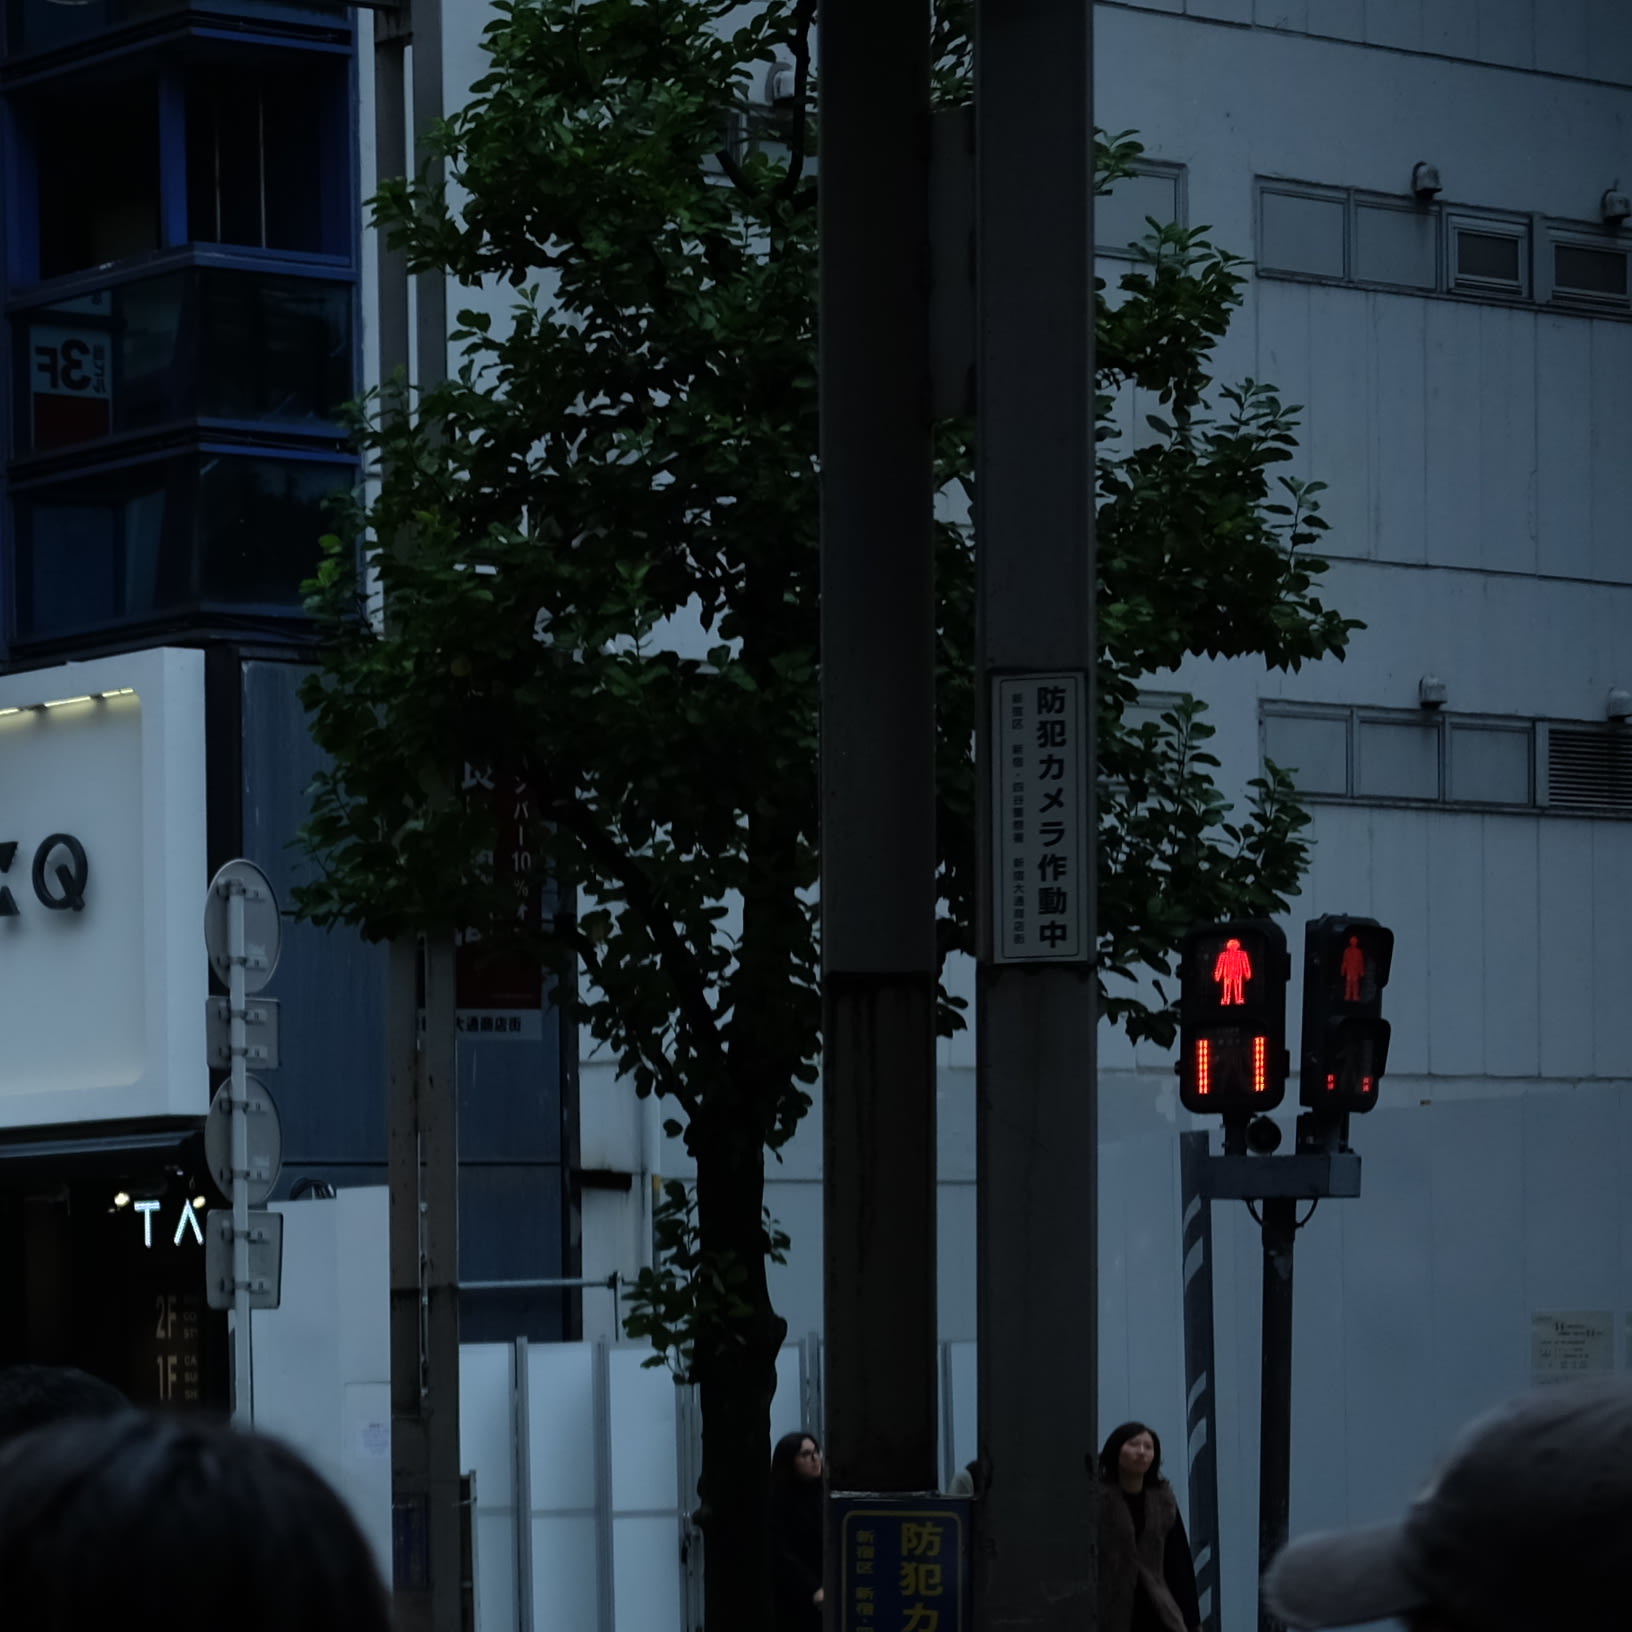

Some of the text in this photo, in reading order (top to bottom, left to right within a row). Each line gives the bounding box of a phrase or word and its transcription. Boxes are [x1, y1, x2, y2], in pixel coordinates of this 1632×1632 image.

[1037, 686, 1067, 948] 防犯カメラ作動中
